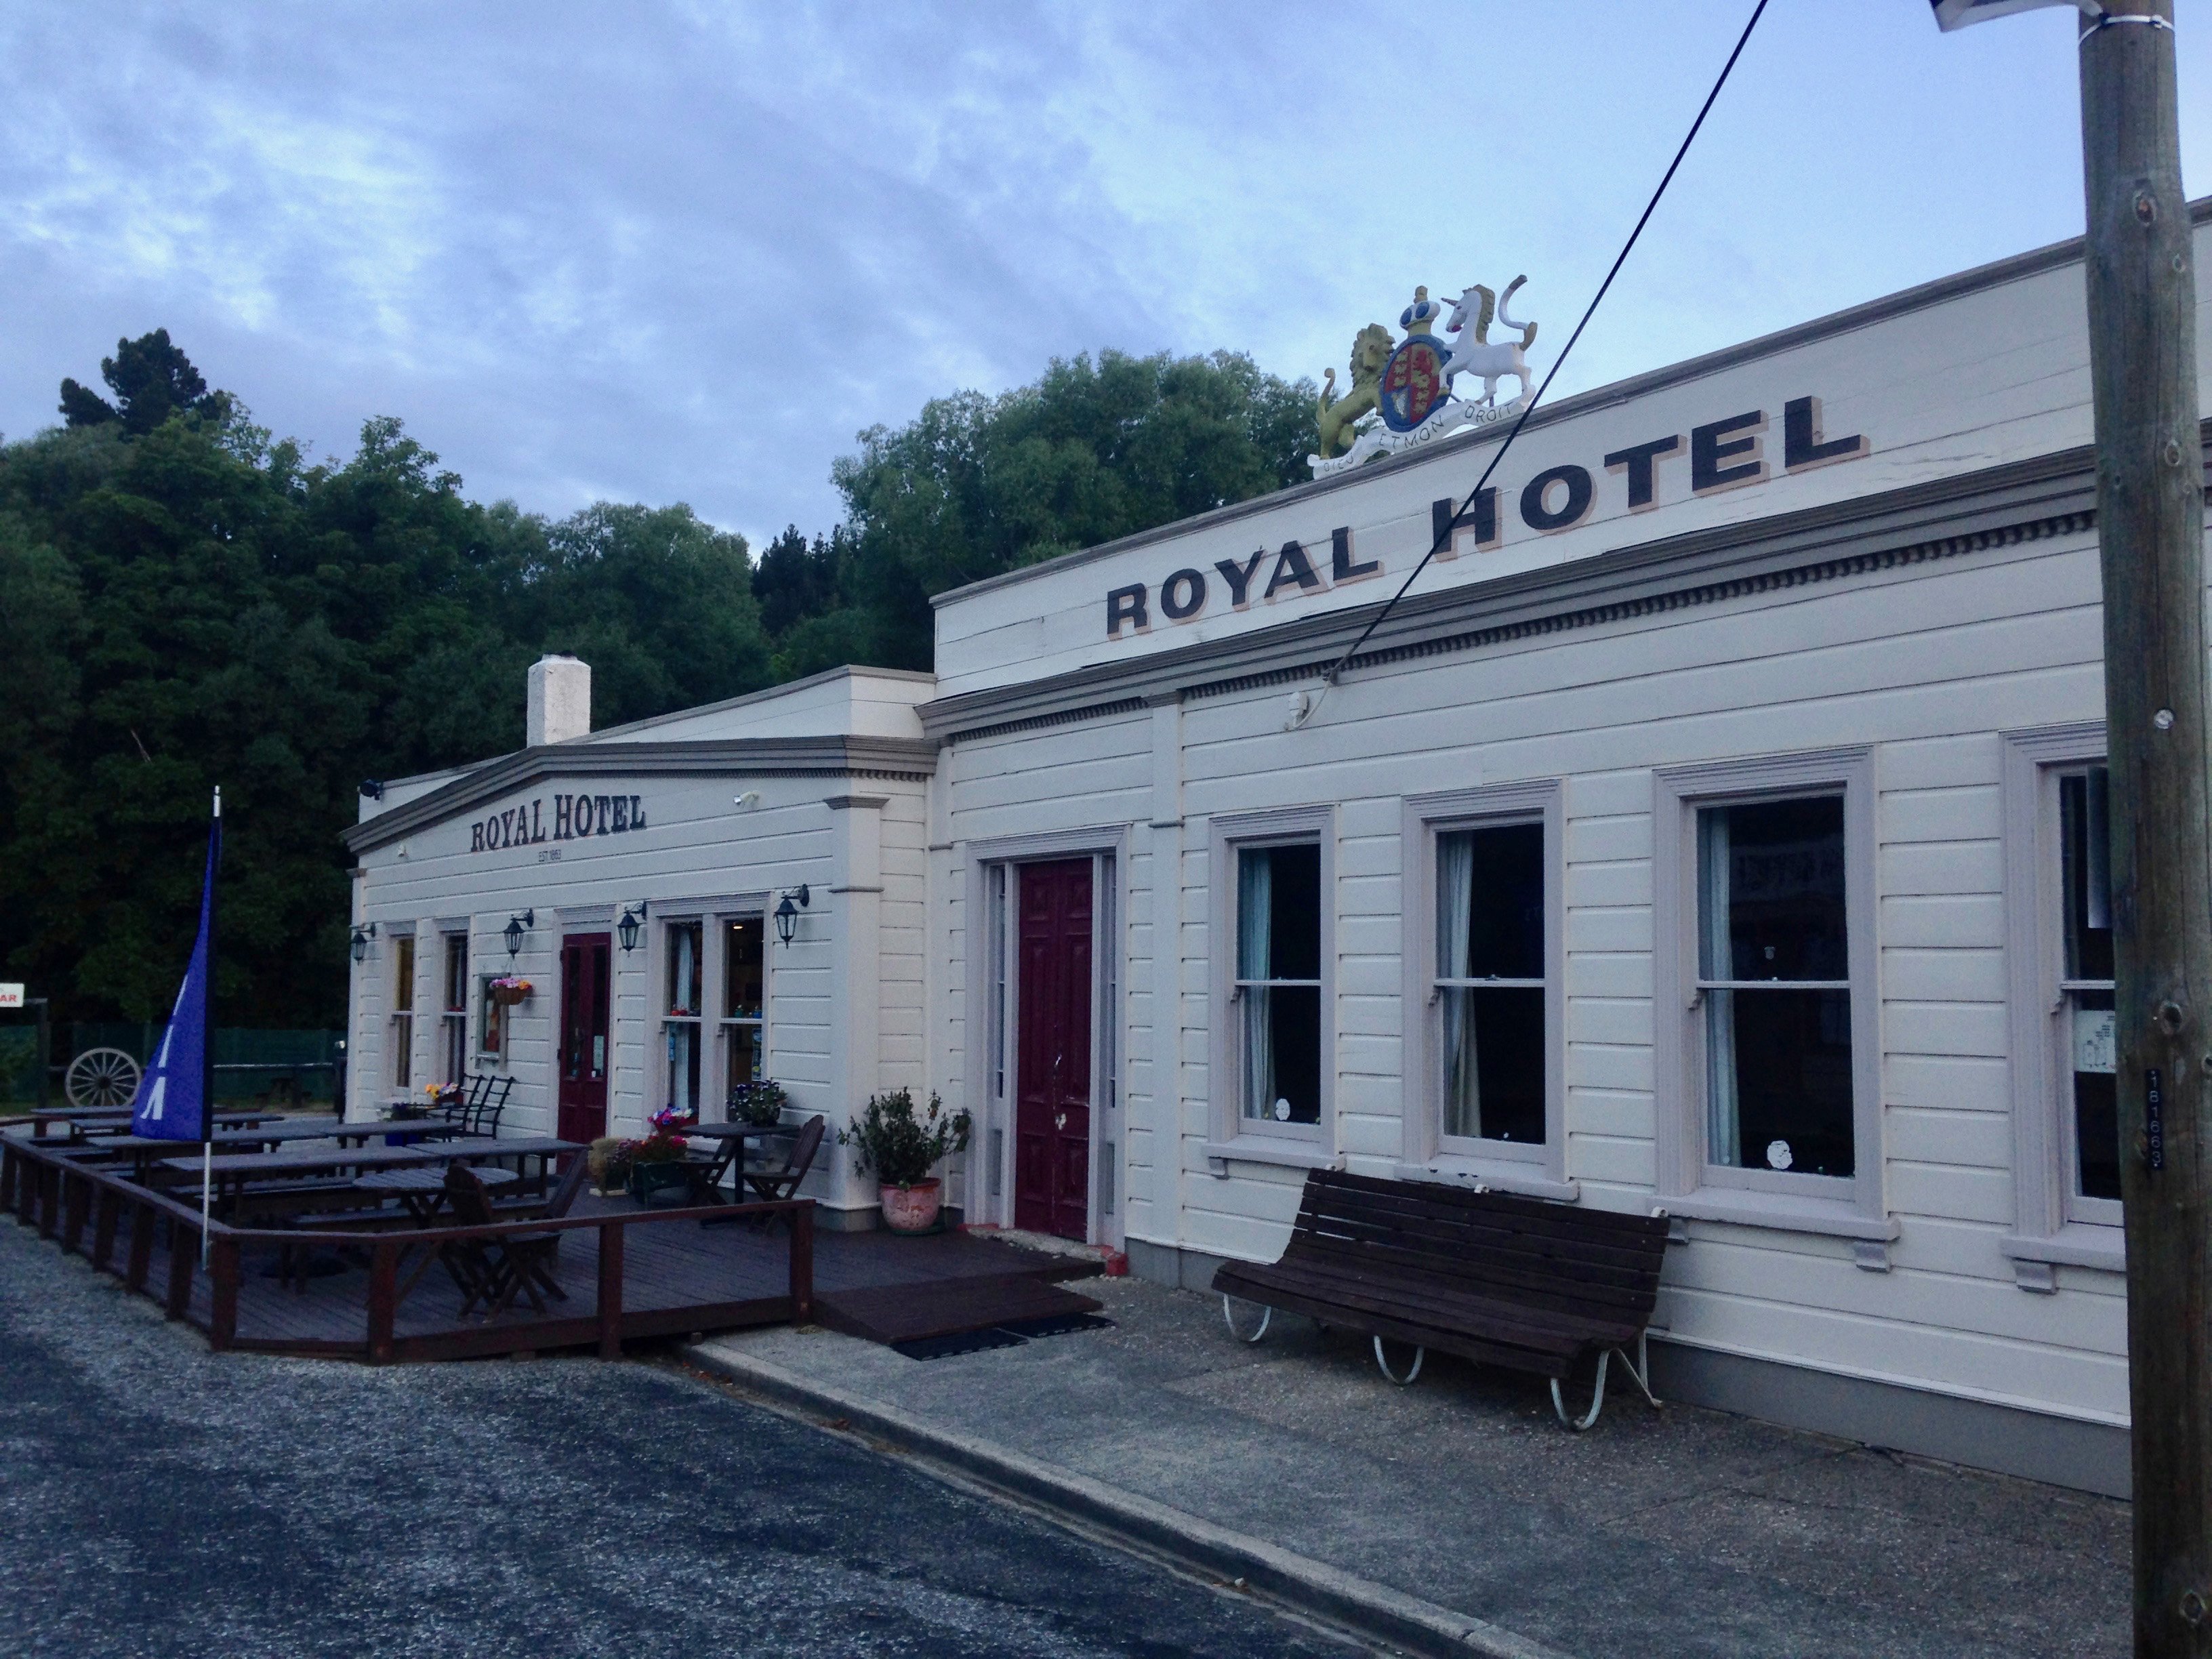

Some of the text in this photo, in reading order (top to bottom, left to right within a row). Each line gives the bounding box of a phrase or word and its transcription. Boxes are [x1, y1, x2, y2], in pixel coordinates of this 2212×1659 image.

[1324, 452, 1353, 472] DIEU
[1465, 403, 1512, 424] DROIT
[1107, 395, 1870, 641] ROYAL HOTEL
[470, 794, 647, 853] ROYAL HOTEL
